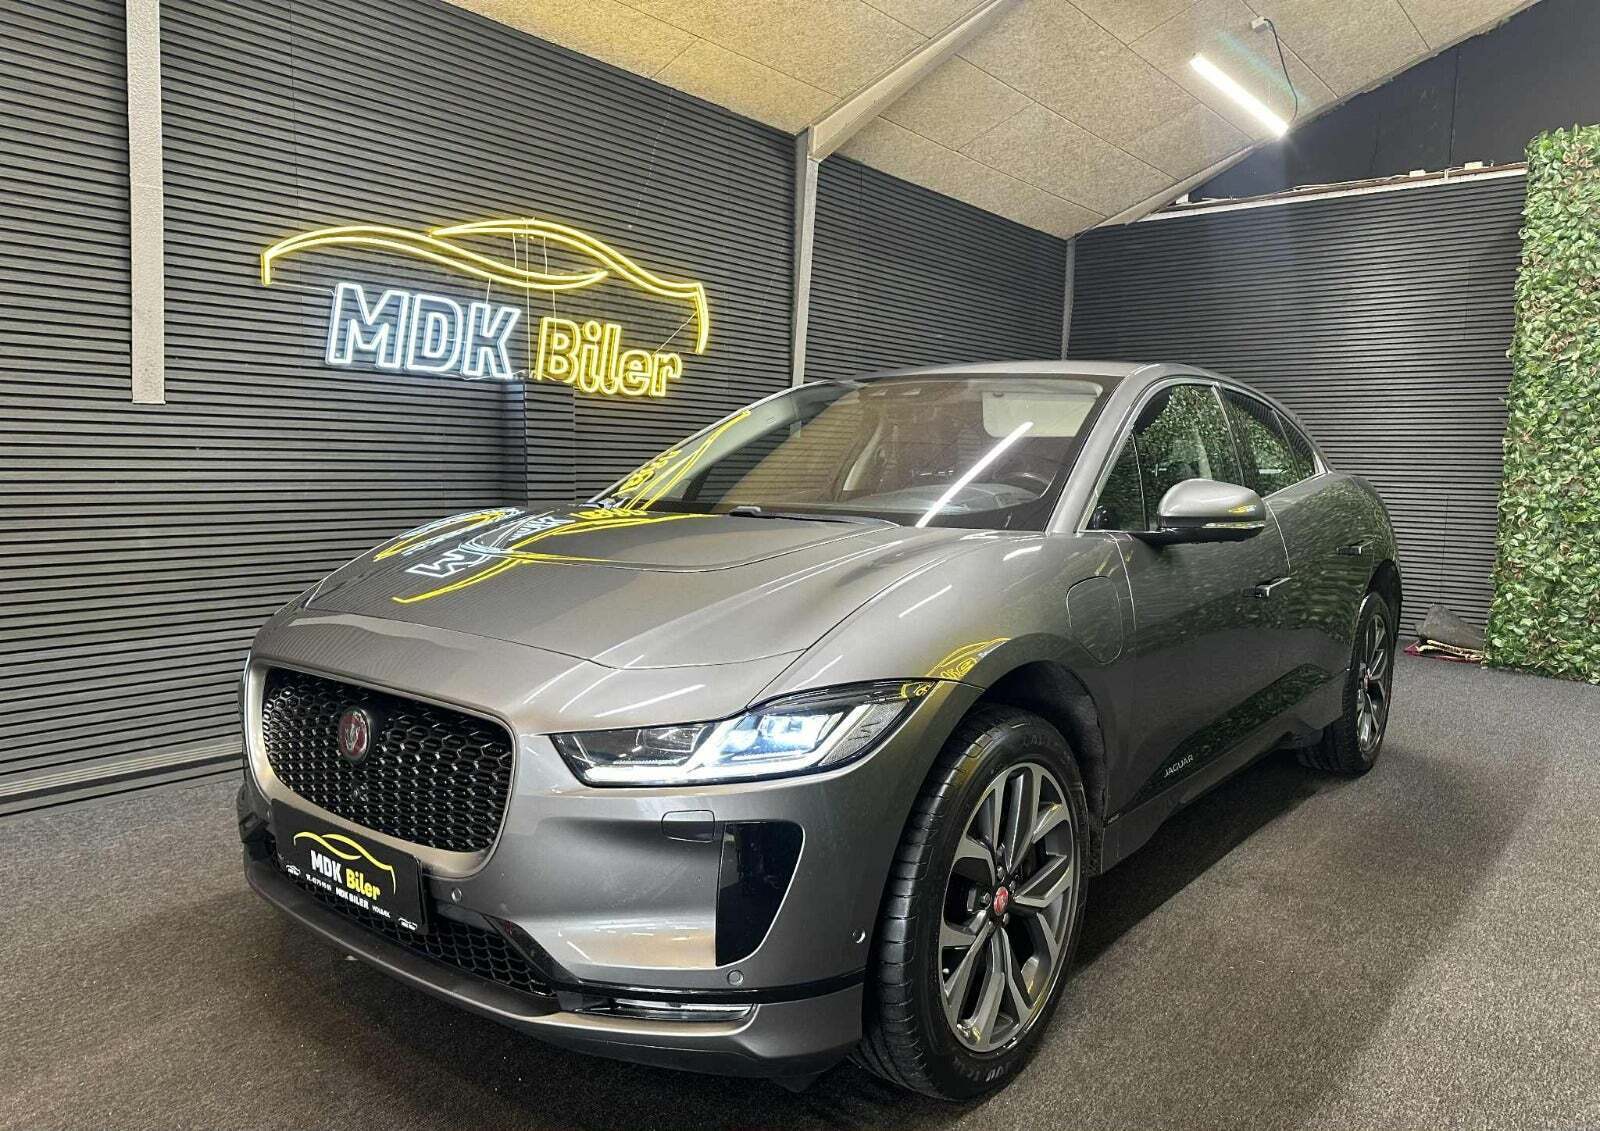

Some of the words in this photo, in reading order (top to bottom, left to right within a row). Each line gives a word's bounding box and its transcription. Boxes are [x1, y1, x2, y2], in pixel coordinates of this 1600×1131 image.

[325, 282, 521, 380] MDK
[535, 316, 684, 398] Biler
[1163, 754, 1194, 778] JAGUAR
[310, 849, 343, 884] MDK
[345, 868, 381, 901] Biler
